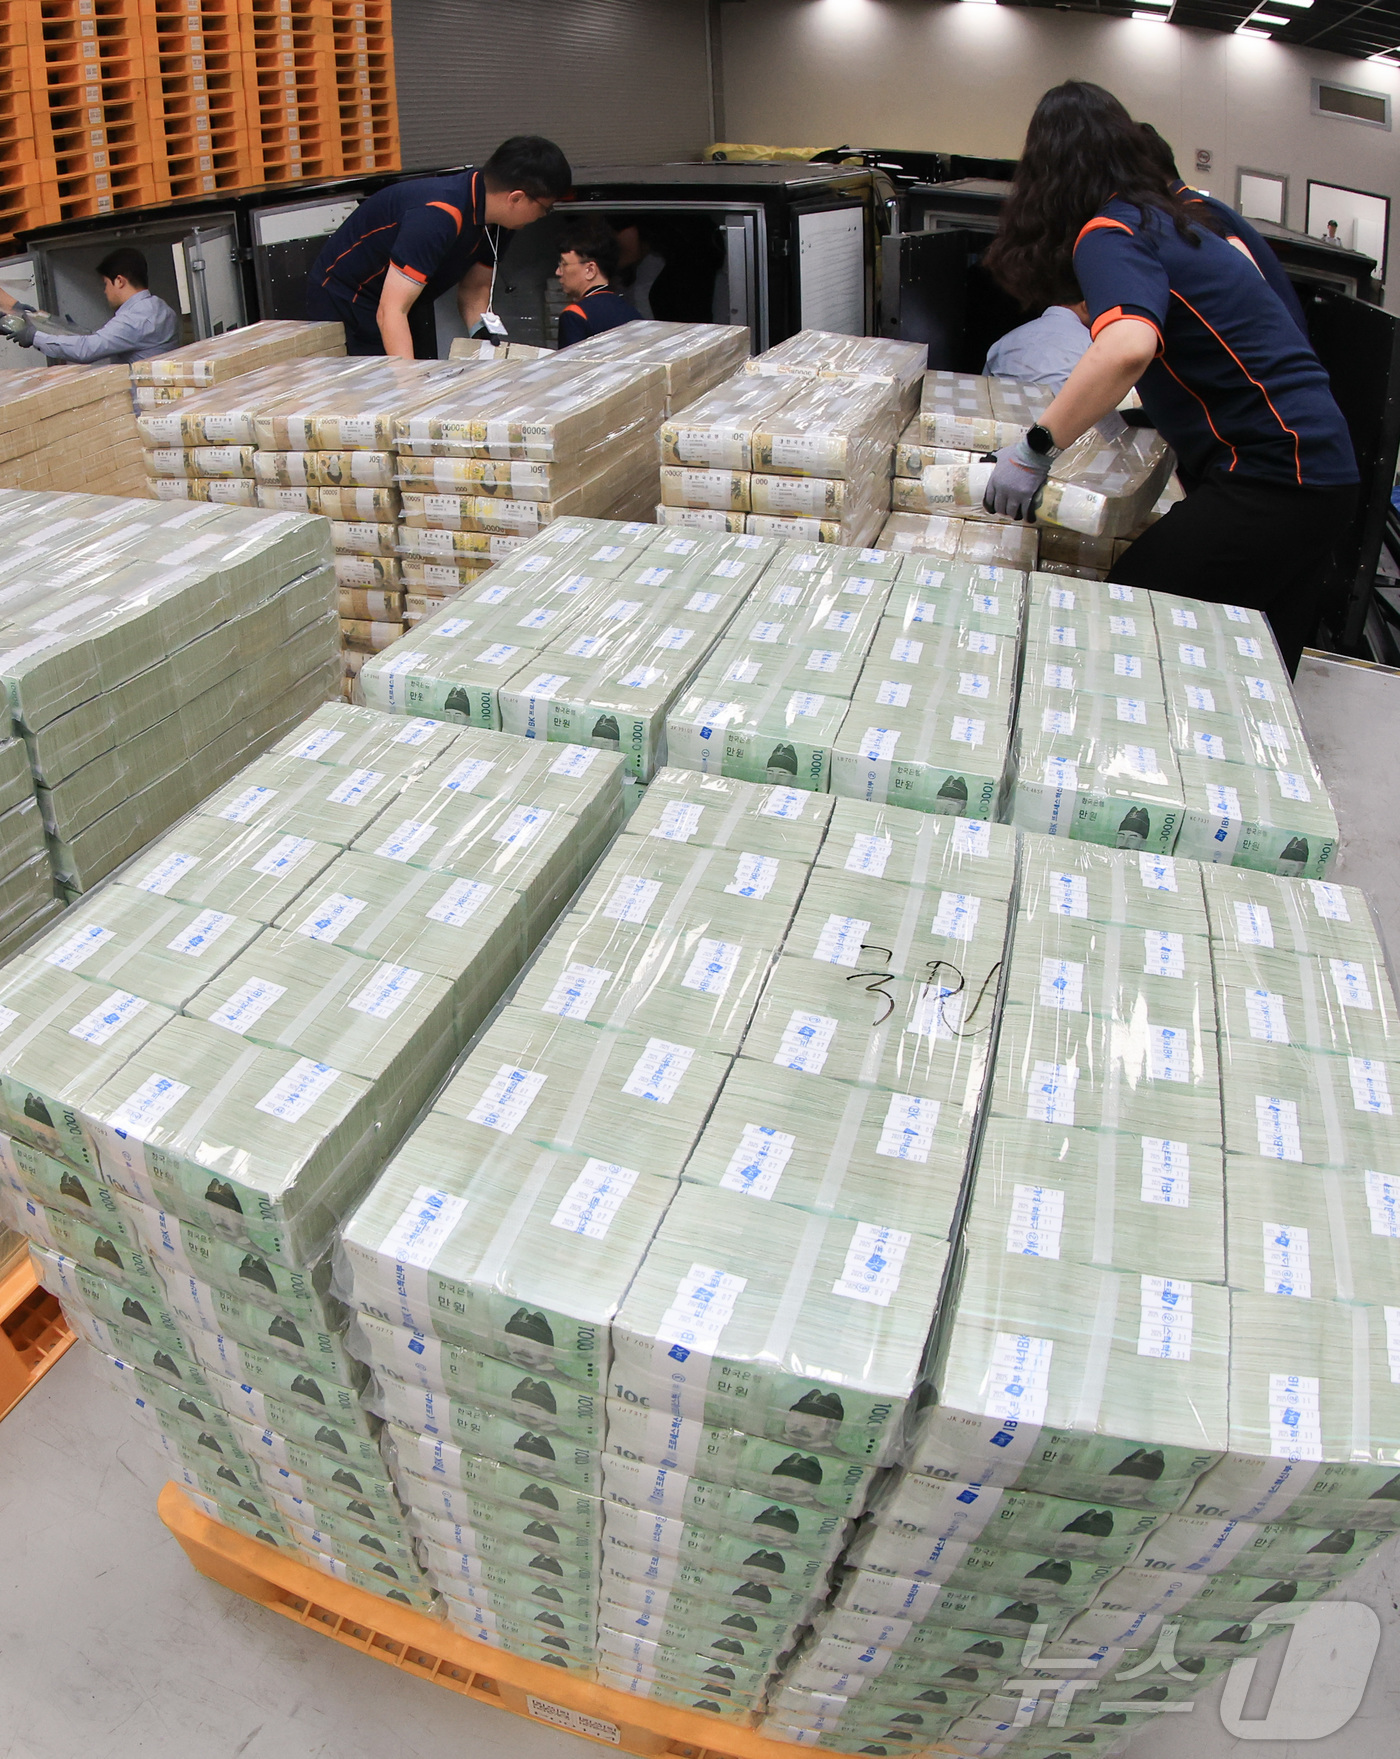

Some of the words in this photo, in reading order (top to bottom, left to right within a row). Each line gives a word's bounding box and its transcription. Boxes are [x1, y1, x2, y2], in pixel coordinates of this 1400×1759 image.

[553, 717, 570, 729] 만원
[727, 746, 744, 758] 만원
[895, 778, 914, 790] 만원
[1079, 810, 1097, 821] 만원
[438, 1296, 465, 1314] 만원
[718, 1381, 748, 1397] 만원
